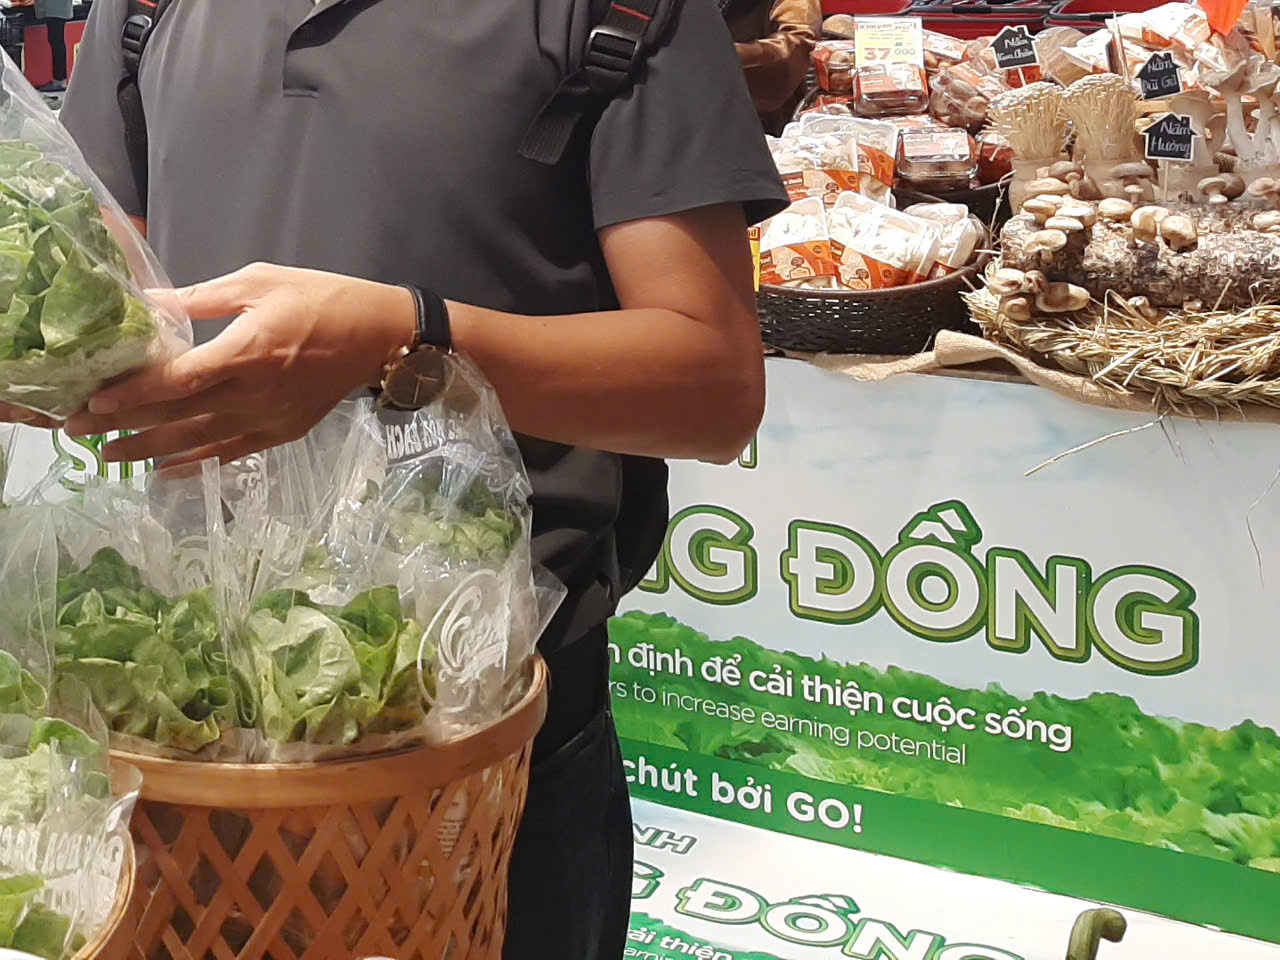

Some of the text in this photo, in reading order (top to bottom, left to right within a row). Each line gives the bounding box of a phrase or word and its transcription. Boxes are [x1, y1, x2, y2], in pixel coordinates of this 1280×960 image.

[864, 48, 891, 60] 37
[780, 499, 1199, 676] ĐỒNG
[628, 642, 1072, 753] định để cải thiện cuộc sống
[633, 681, 967, 767] to increase earning potential
[622, 756, 863, 834] chút bởi GO!
[633, 822, 697, 855] NH
[674, 878, 1026, 960] ĐỒN
